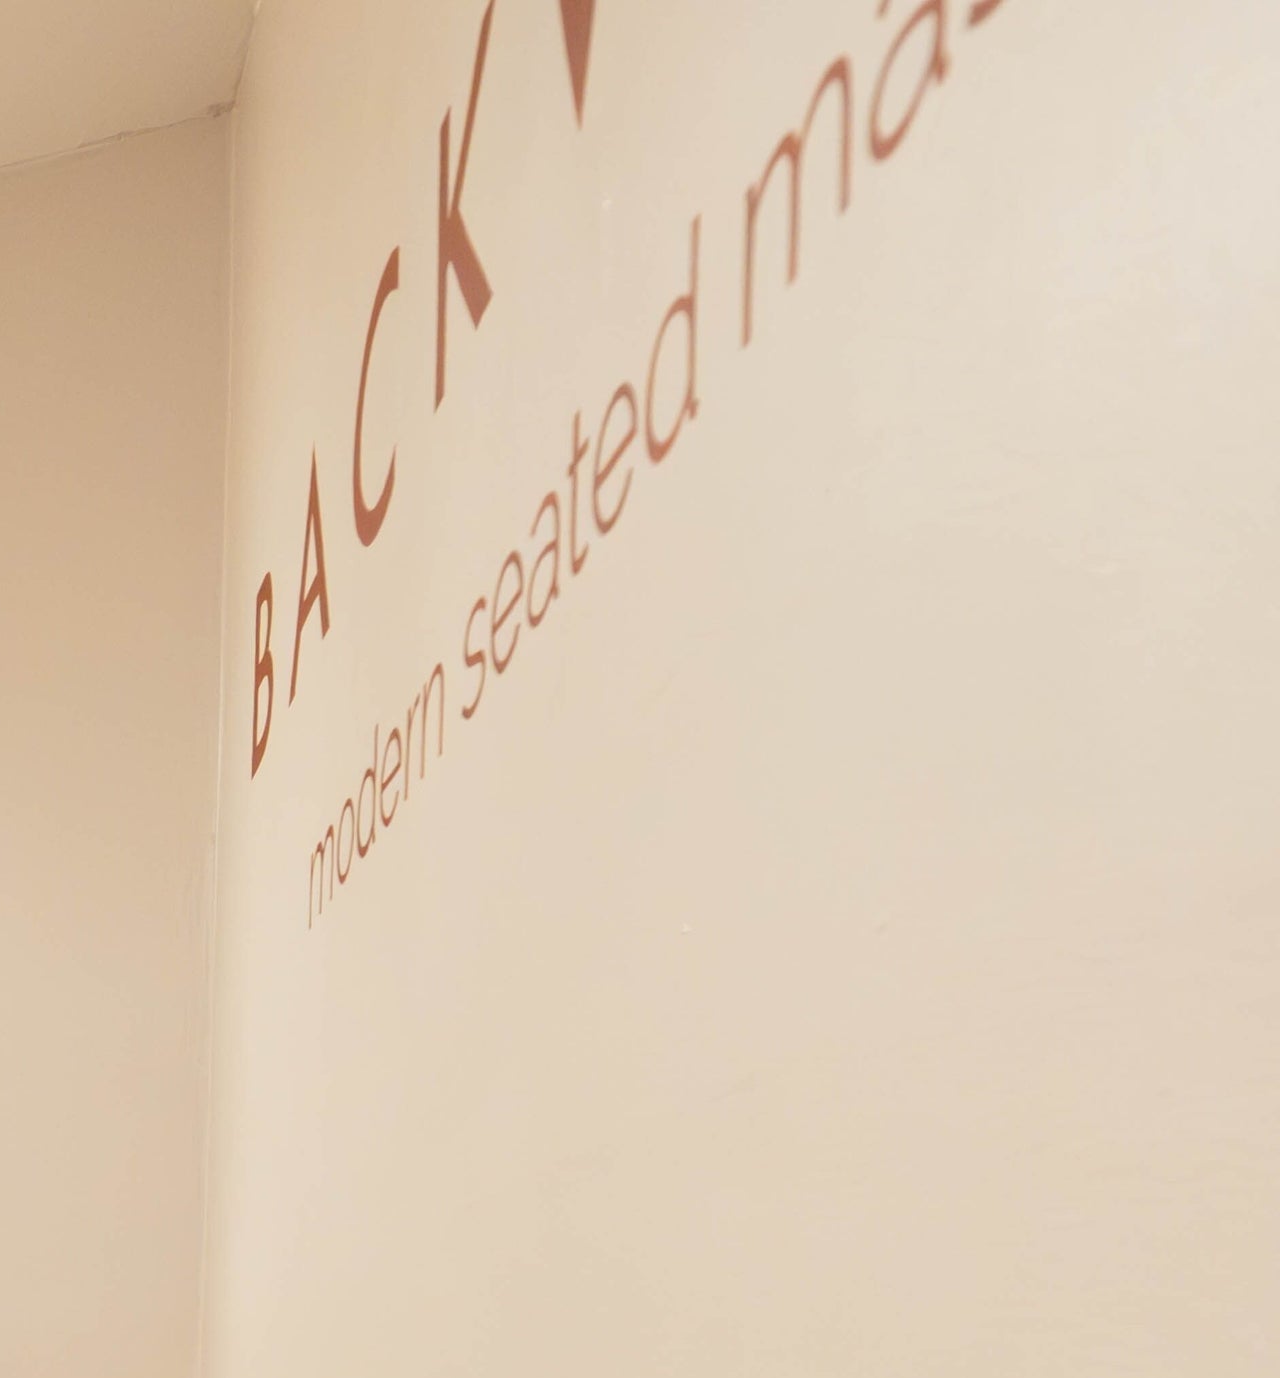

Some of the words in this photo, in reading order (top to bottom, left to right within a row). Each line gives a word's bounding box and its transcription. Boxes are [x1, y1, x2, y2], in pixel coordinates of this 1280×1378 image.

[250, 0, 597, 782] BACK
[307, 659, 445, 931] modern
[460, 213, 702, 721] seated
[742, 0, 1005, 349] ma
